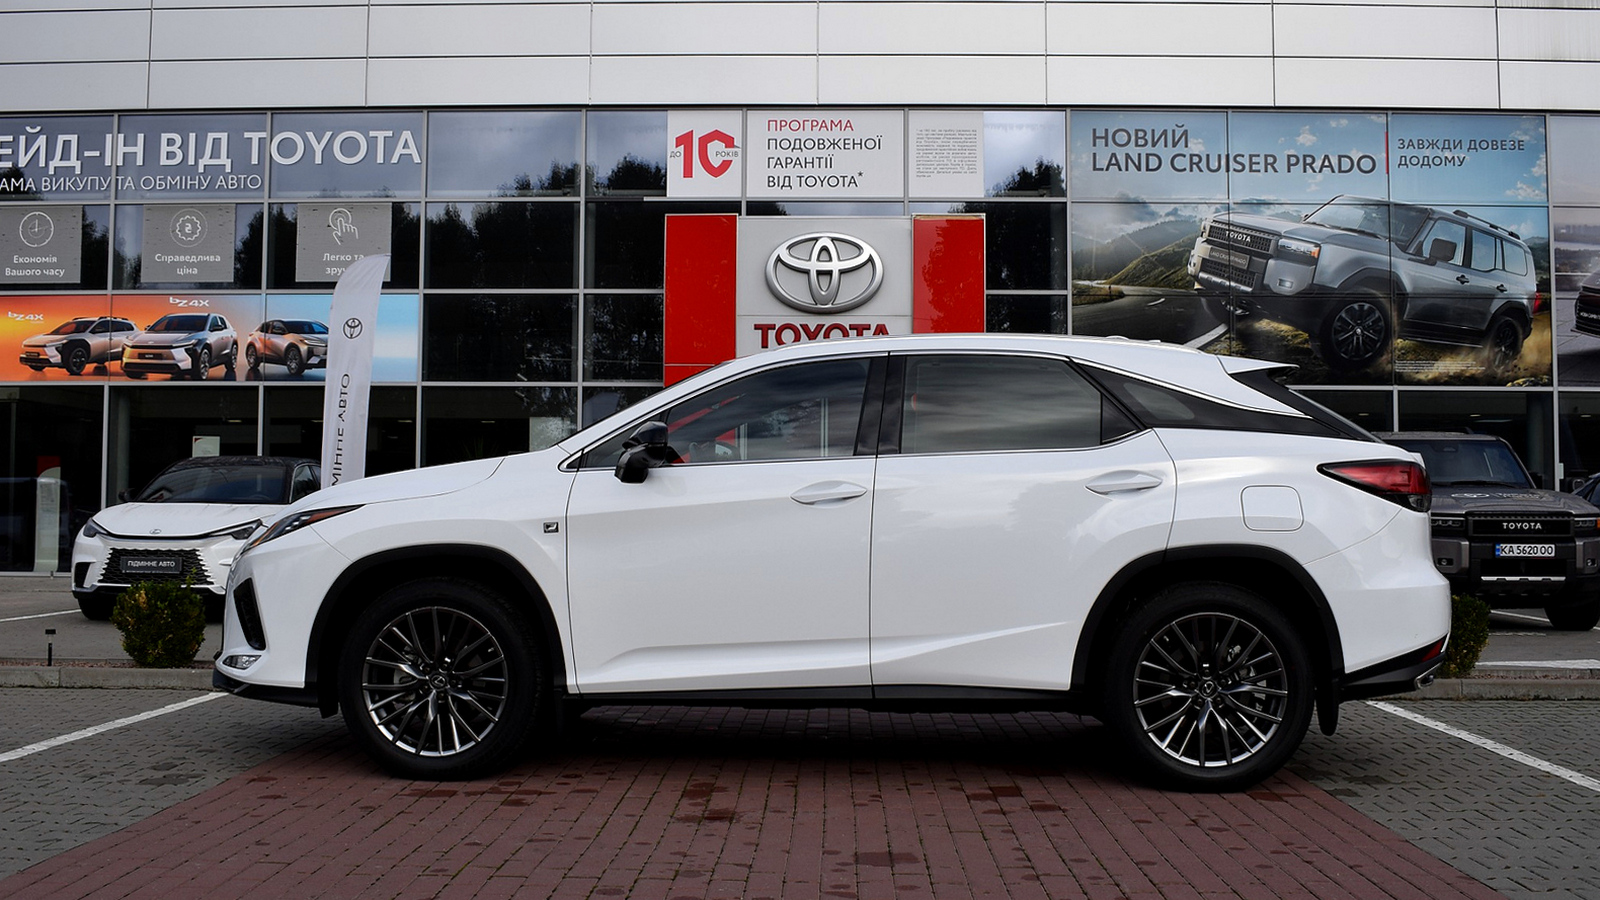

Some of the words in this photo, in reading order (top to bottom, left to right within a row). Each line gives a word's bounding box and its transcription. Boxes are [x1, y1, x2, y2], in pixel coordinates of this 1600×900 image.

[767, 119, 854, 132] ПРОГРАМА
[1092, 124, 1189, 148] НОВИЙ
[767, 135, 883, 152] ПОДОВЖЕНОЇ
[1397, 138, 1463, 152] ЗАВЖДИ
[1466, 139, 1525, 153] ДОВЕЗЕ
[159, 131, 232, 173] ВІД
[243, 130, 422, 165] TOYOTA
[767, 153, 834, 169] ГАРАНТІЇ
[1092, 152, 1163, 172] LAND
[1169, 153, 1278, 173] CRUISER
[1286, 154, 1377, 175] PRADO
[1397, 155, 1466, 169] ДОДОМУ
[41, 176, 111, 192] ВИКУПУ
[116, 176, 135, 190] ТА
[140, 175, 211, 190] ОБМІНУ
[215, 174, 262, 190] АВТО
[767, 175, 793, 190] ВІД
[1225, 230, 1251, 243] TOYOTA
[13, 255, 58, 264] Економія
[154, 253, 221, 263] Справедлива
[322, 253, 352, 261] Легко
[5, 267, 42, 276] Вашого
[43, 268, 65, 277] часу
[176, 266, 198, 275] ціна
[1502, 522, 1542, 530] TOYOTA
[1501, 545, 1515, 555] KA
[1516, 545, 1537, 555] 5620
[158, 560, 176, 568] АВТО
